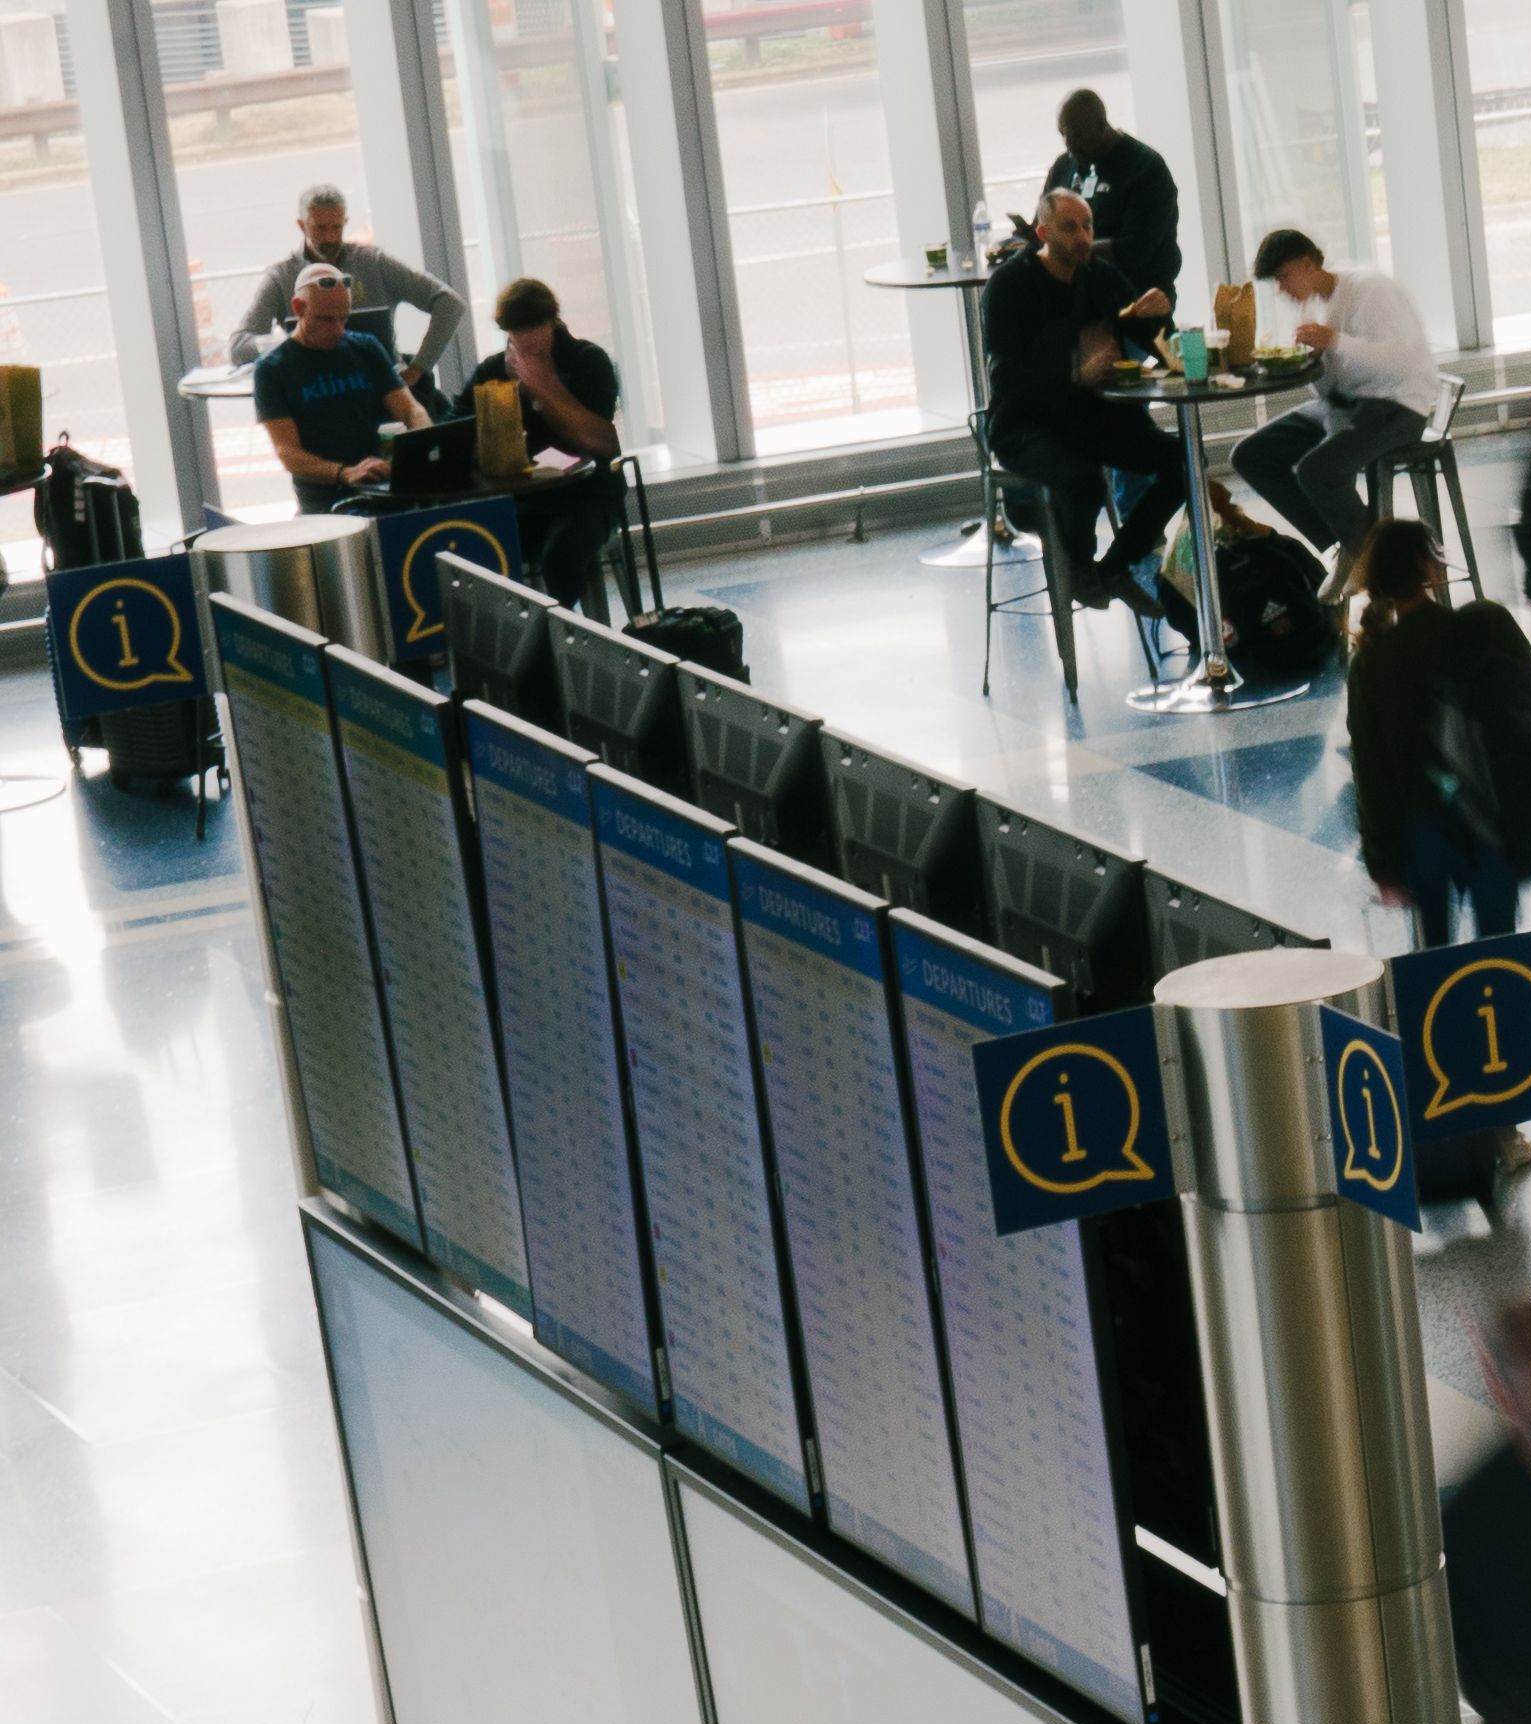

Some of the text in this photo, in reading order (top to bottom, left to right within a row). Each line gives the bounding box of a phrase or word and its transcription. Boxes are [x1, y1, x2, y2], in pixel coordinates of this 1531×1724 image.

[488, 743, 558, 797] DEPARTURES
[615, 808, 693, 868] DEPARTURES
[757, 884, 842, 946] DEPARTURES
[921, 958, 1014, 1026] DEPARTURES
